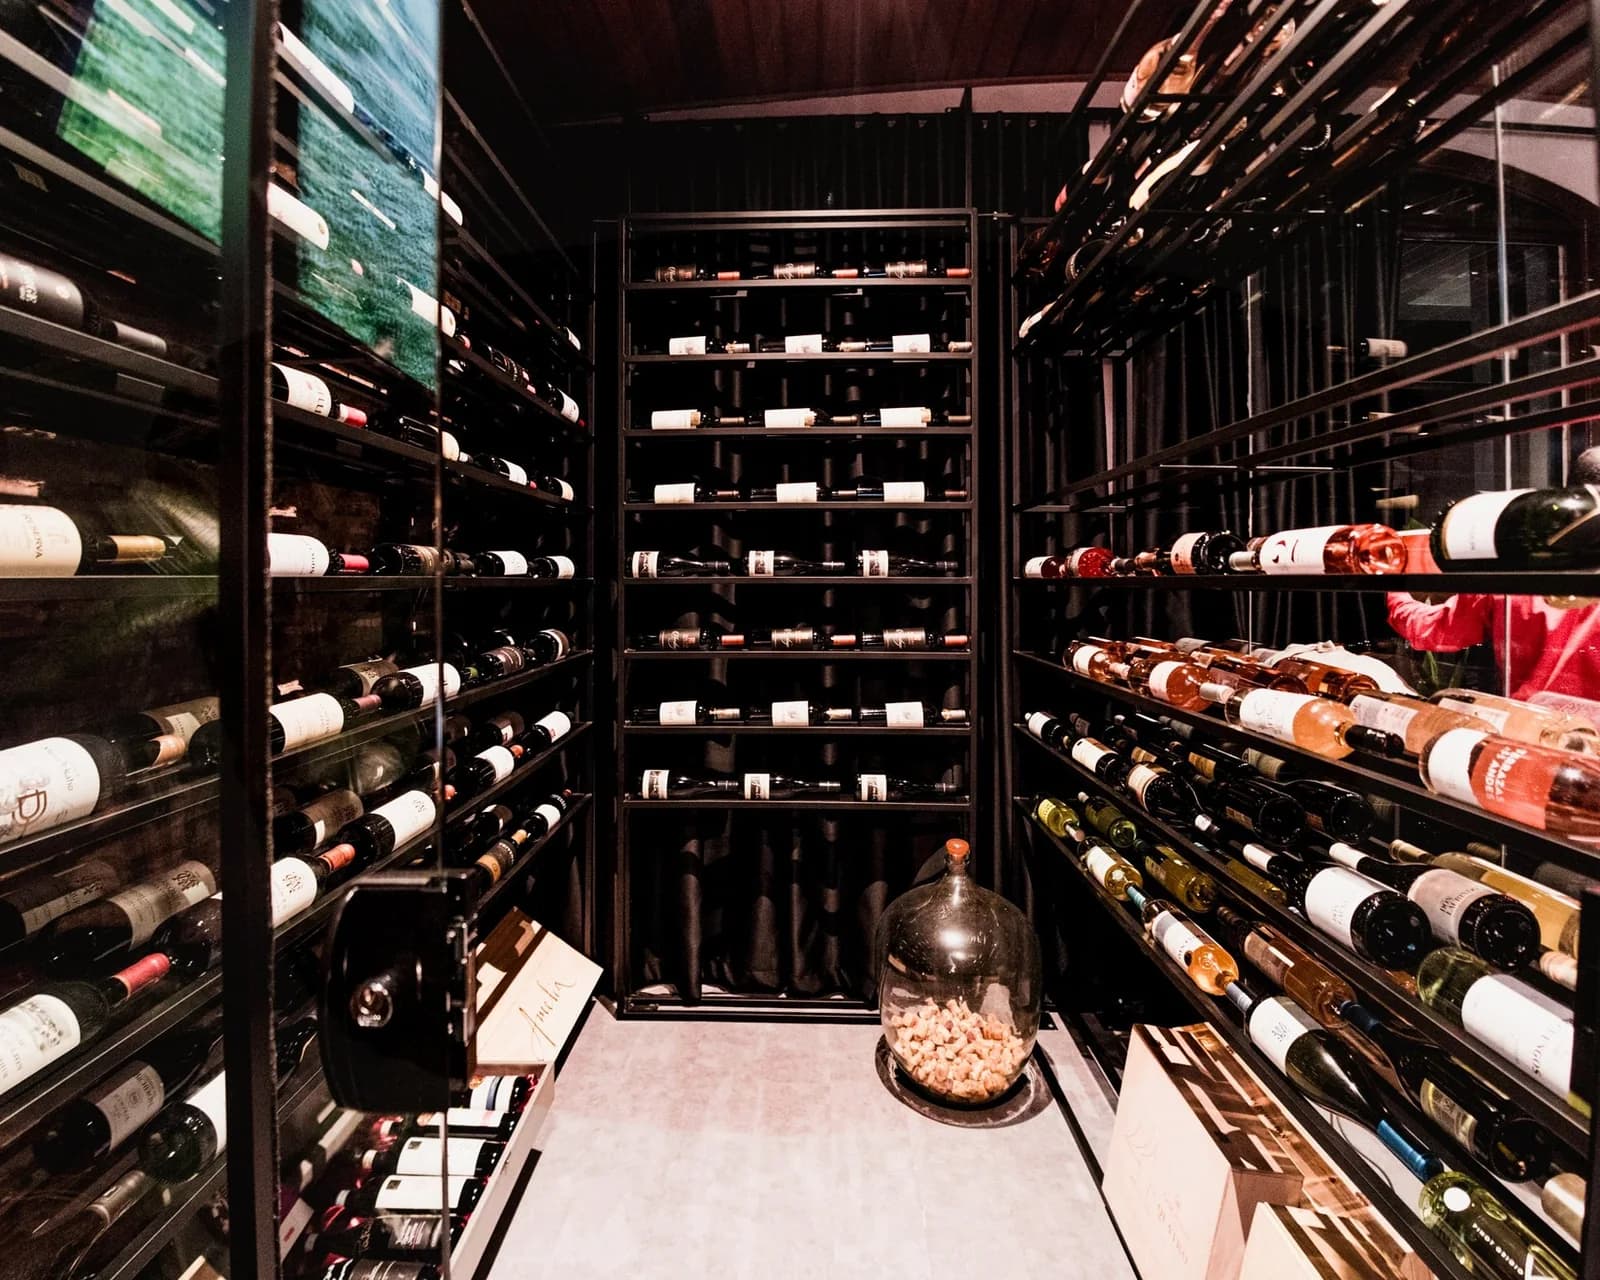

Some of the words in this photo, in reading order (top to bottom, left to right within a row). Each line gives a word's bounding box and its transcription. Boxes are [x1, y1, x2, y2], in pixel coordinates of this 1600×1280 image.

[1485, 759, 1500, 801] ANDES
[1495, 747, 1528, 803] TERRAZAS
[1471, 1222, 1495, 1246] PINOT
[1495, 1246, 1524, 1276] GRIGIO
